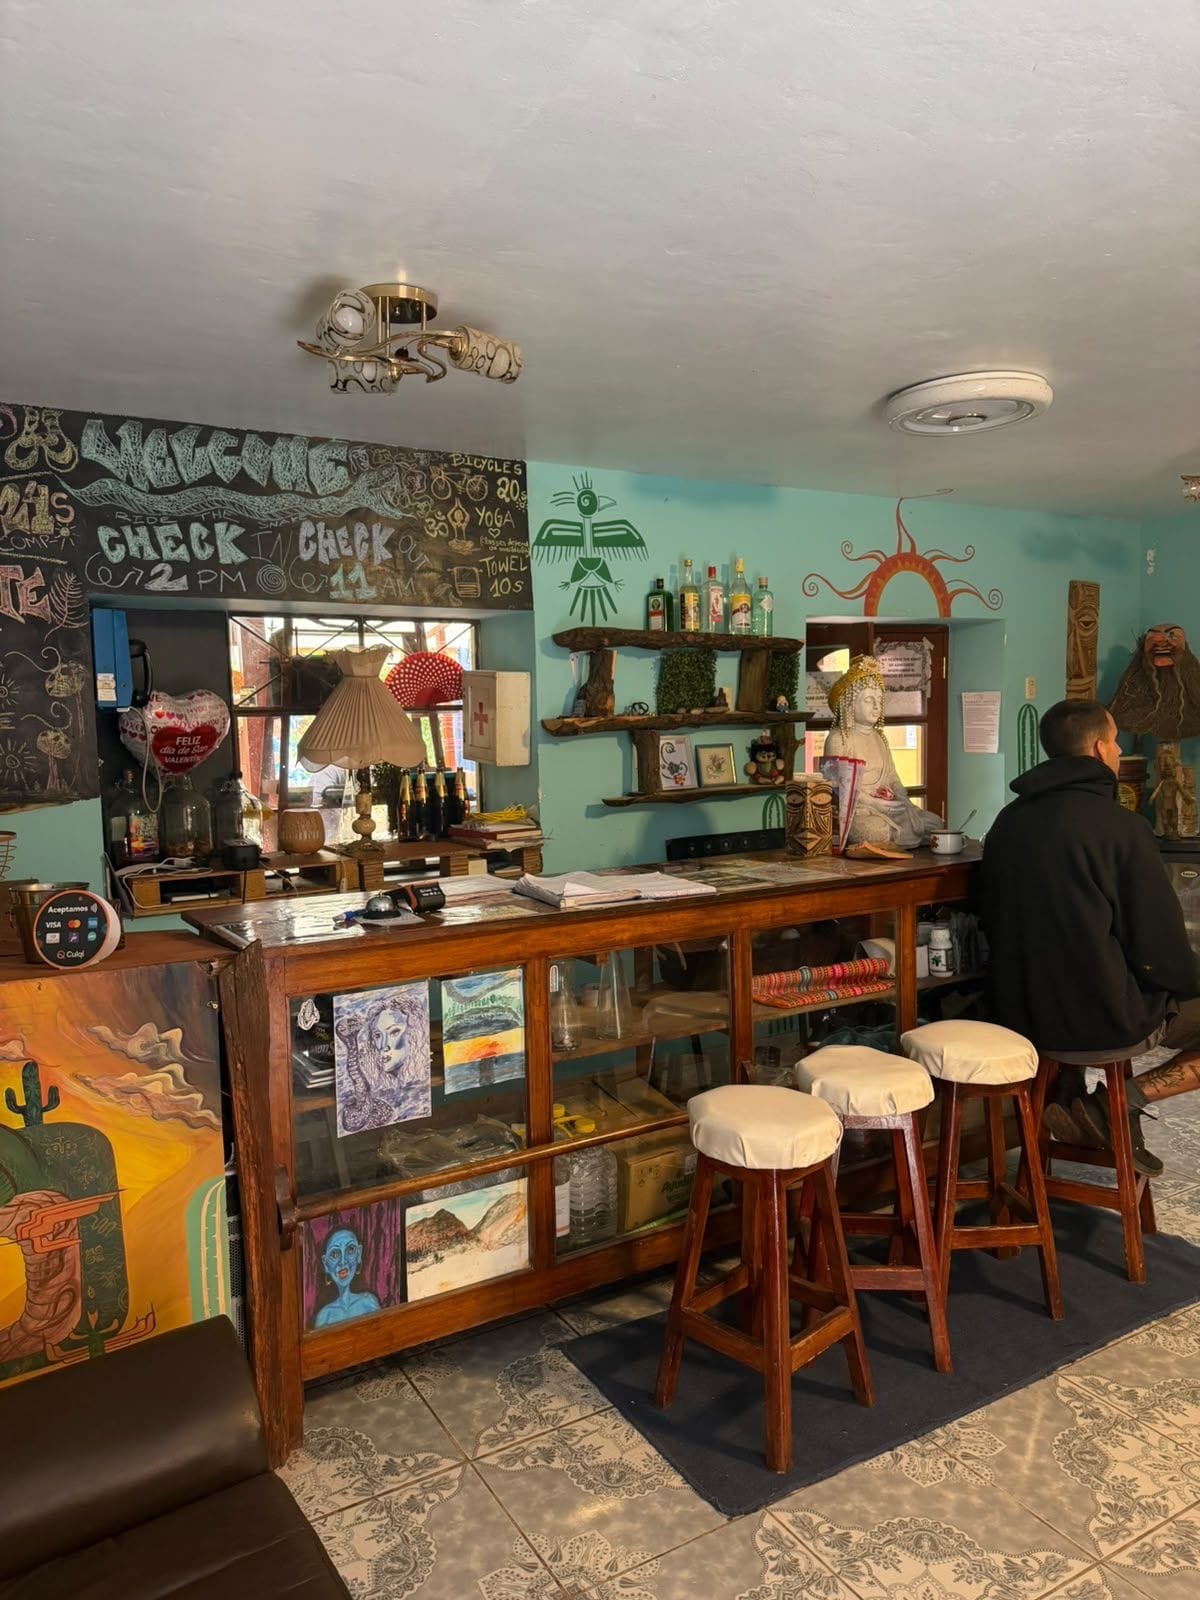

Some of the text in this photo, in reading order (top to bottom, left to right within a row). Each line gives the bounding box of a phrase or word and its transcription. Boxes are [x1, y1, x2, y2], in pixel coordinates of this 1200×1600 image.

[81, 418, 349, 497] WELCOME
[450, 452, 522, 476] BICYCLES
[115, 511, 178, 525] RIDE
[201, 509, 241, 523] THE
[475, 506, 516, 529] YOGA
[97, 521, 249, 565] CHECK
[299, 520, 433, 570] CHECK OUT
[144, 562, 247, 593] 2 PM
[479, 554, 528, 578] TOWEL
[329, 564, 417, 600] 11 AM
[175, 735, 202, 746] FELIZ
[177, 746, 191, 755] de
[47, 904, 89, 916] Aceptamos
[45, 921, 62, 929] VISA
